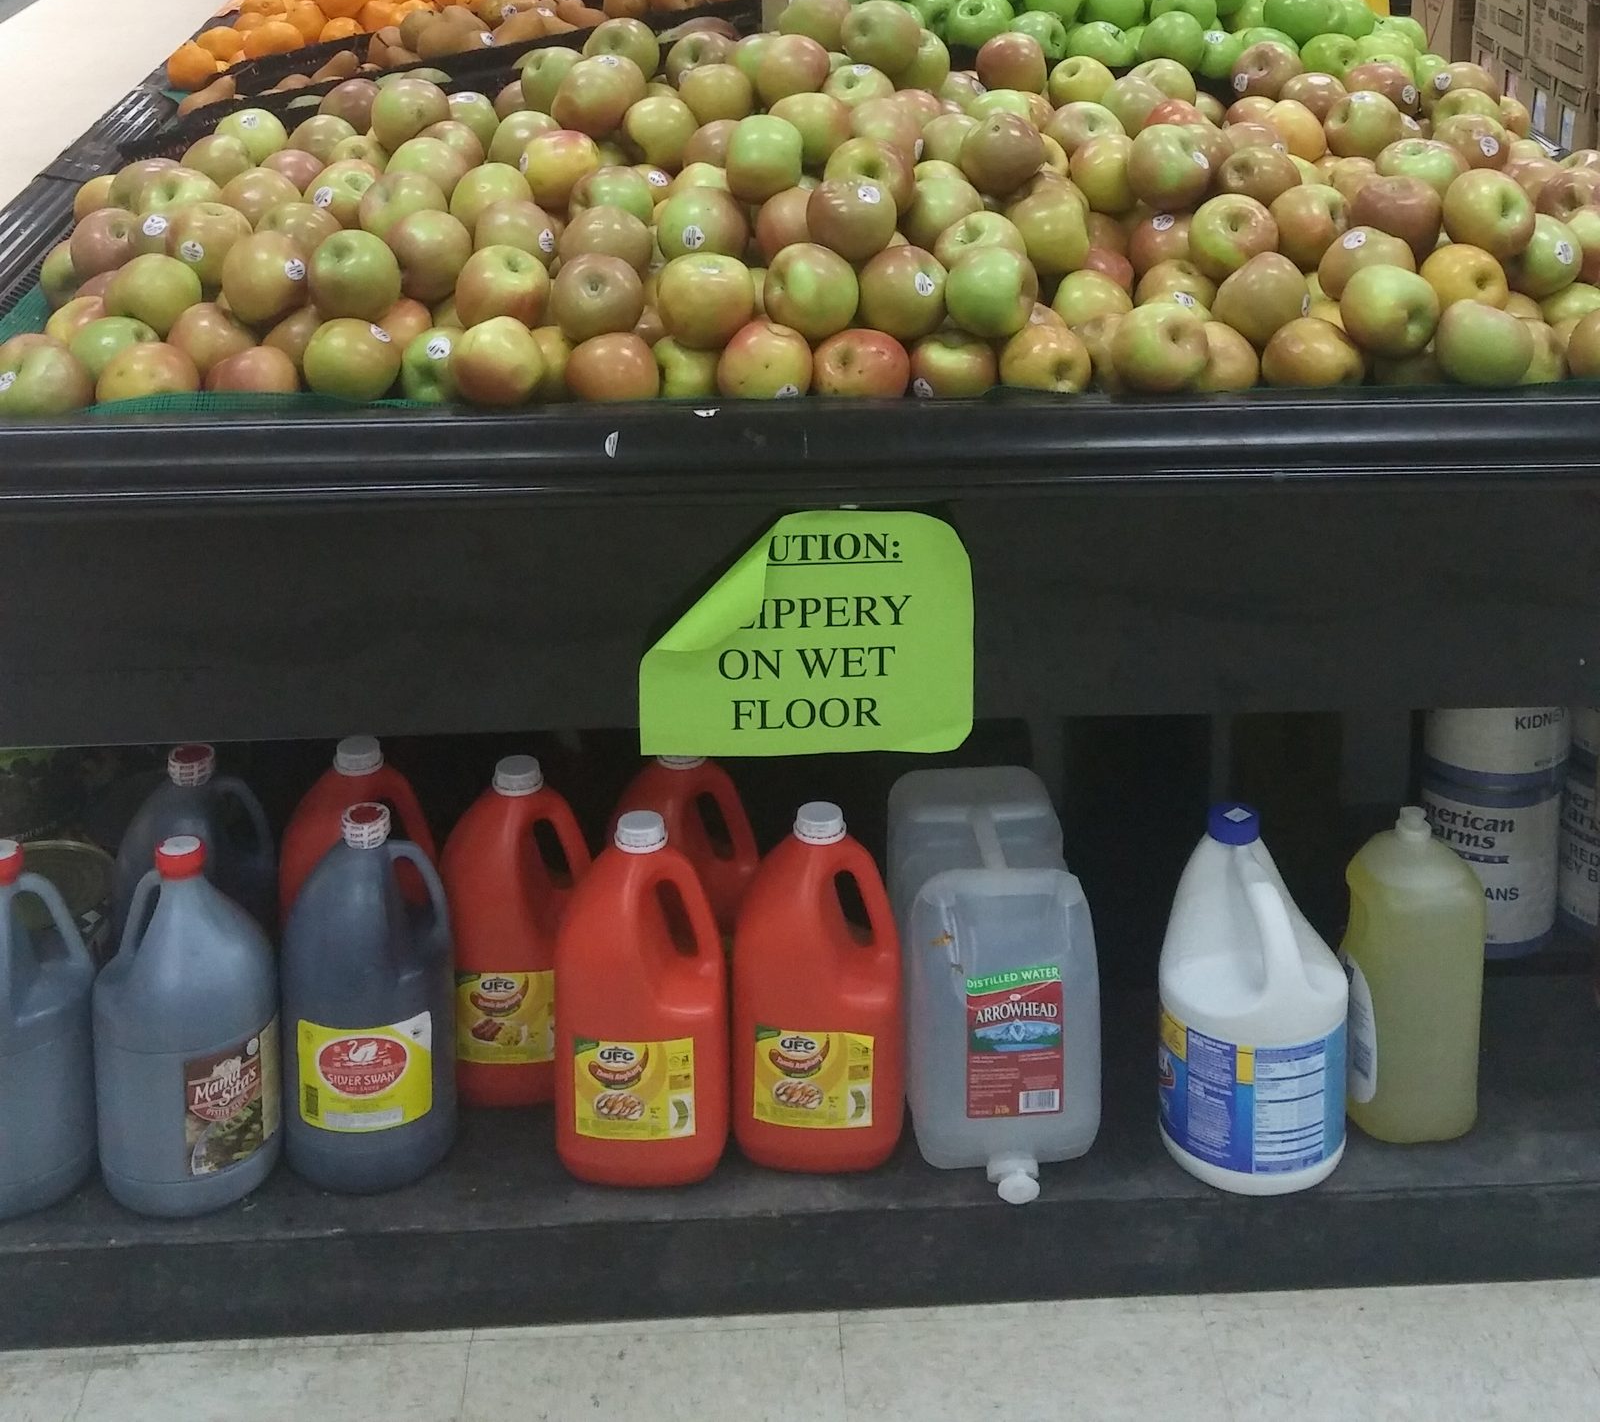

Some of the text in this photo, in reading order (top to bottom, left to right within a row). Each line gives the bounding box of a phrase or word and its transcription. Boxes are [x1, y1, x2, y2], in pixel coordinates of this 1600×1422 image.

[717, 645, 897, 681] ON WET
[731, 696, 882, 731] FLOOR
[1426, 801, 1516, 834] merican
[1431, 821, 1496, 850] arms
[1485, 886, 1520, 902] ANS
[481, 980, 515, 991] UFC
[966, 966, 1059, 989] DISTILLED WATER
[975, 1001, 1058, 1024] ARROWHEAD
[781, 1038, 816, 1050] UFC
[600, 1050, 635, 1062] UFC
[194, 1066, 241, 1105] Mama
[327, 1071, 395, 1086] SILVER SWAN
